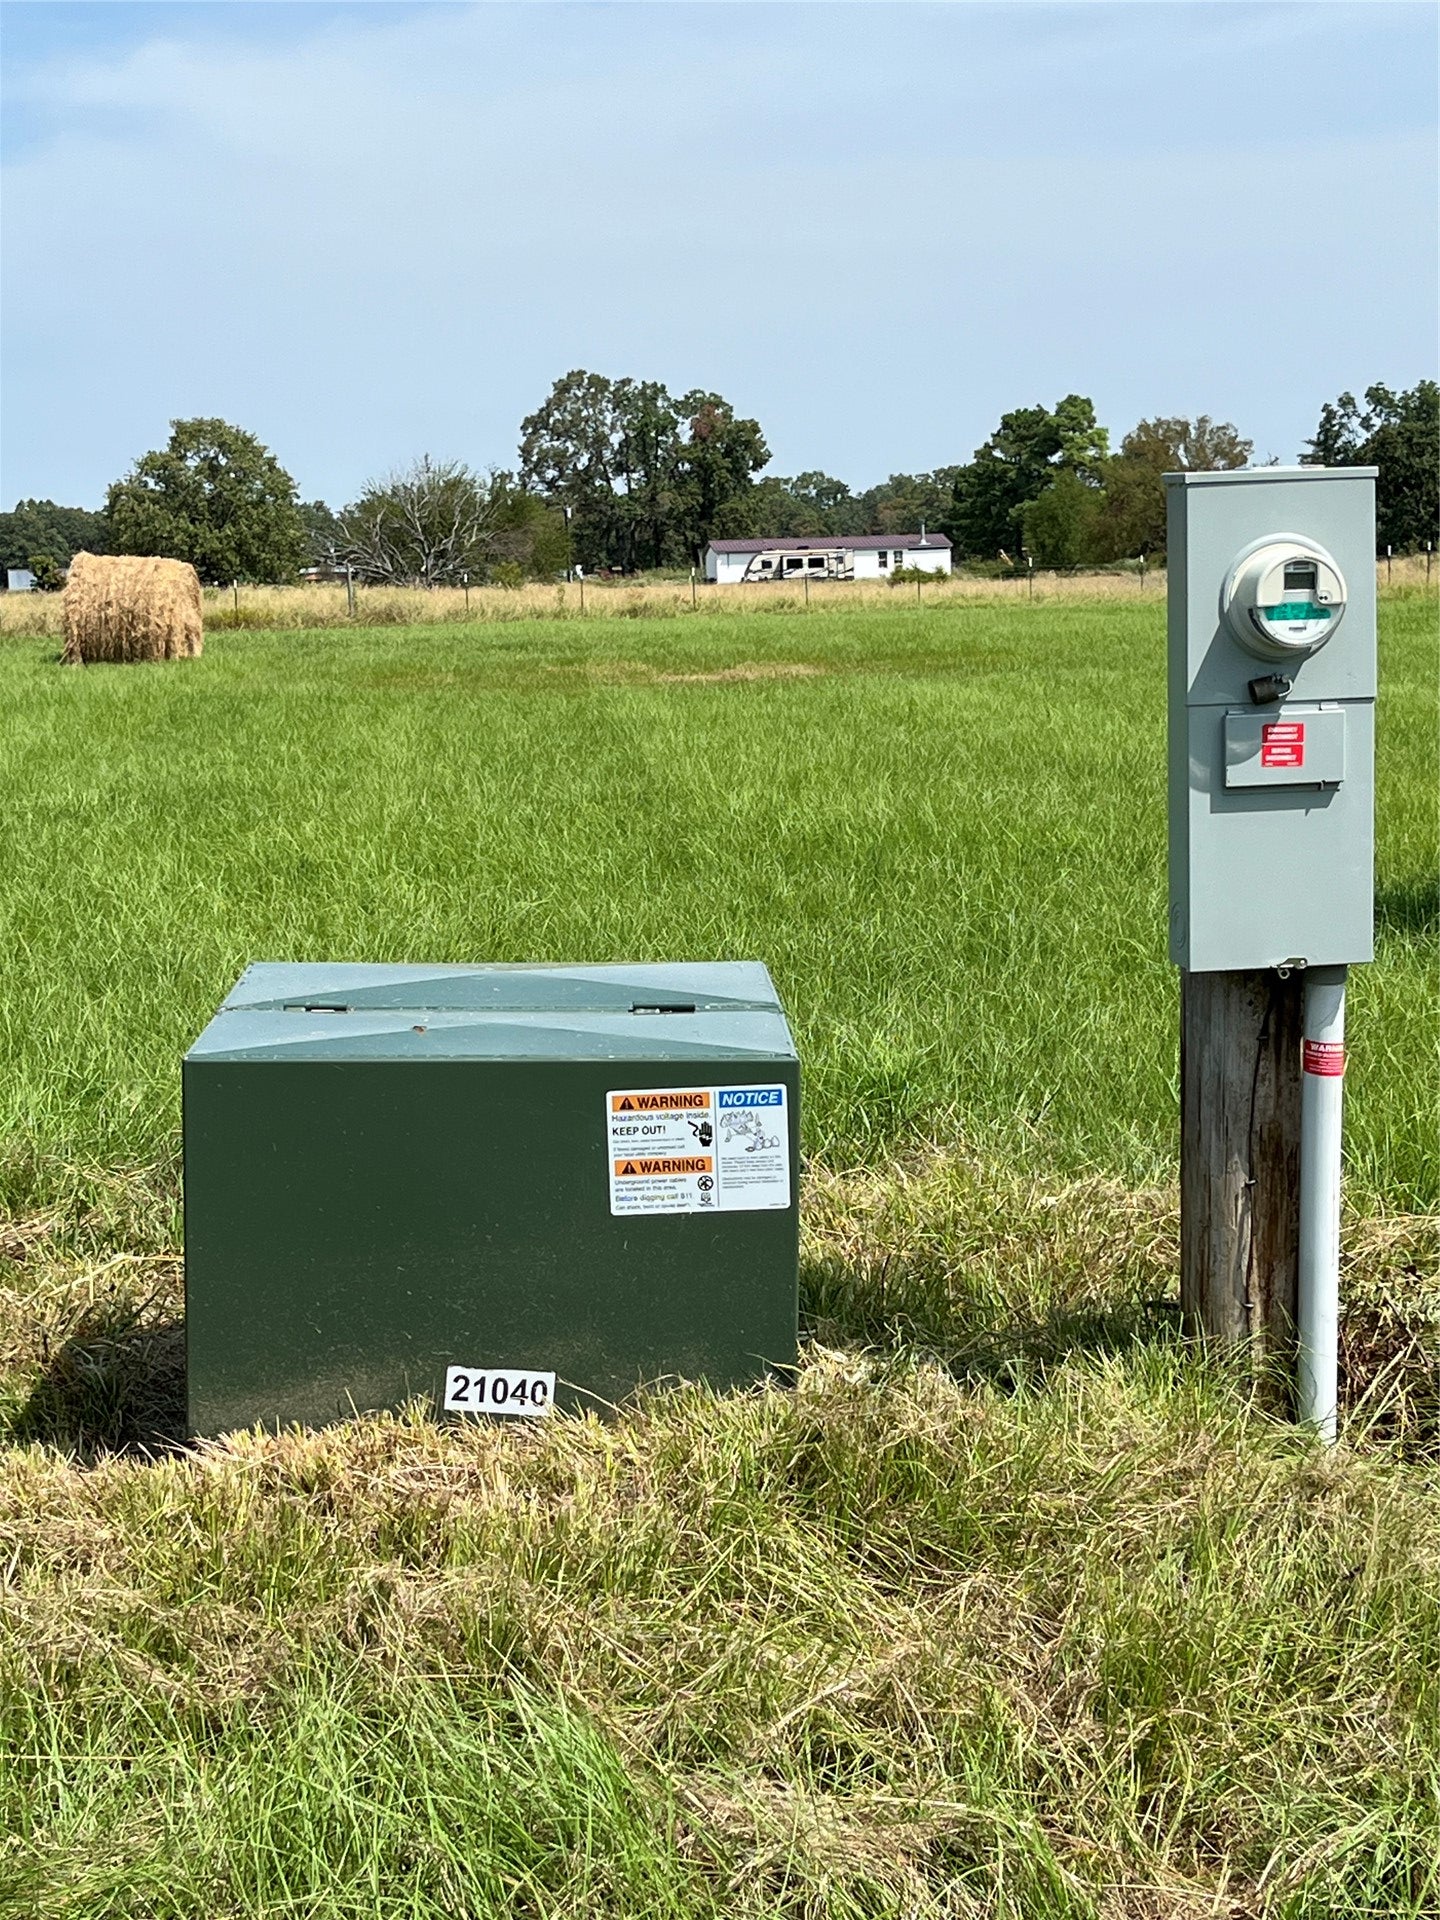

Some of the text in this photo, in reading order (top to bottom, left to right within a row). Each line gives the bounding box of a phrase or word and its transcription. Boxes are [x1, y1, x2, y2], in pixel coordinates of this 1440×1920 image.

[637, 1094, 704, 1108] WARNING
[722, 1092, 780, 1106] NOTICE
[656, 1112, 684, 1121] voltage
[612, 1125, 666, 1136] KEEP OUT!
[640, 1159, 706, 1173] WARNING
[451, 1374, 548, 1407] 21040
